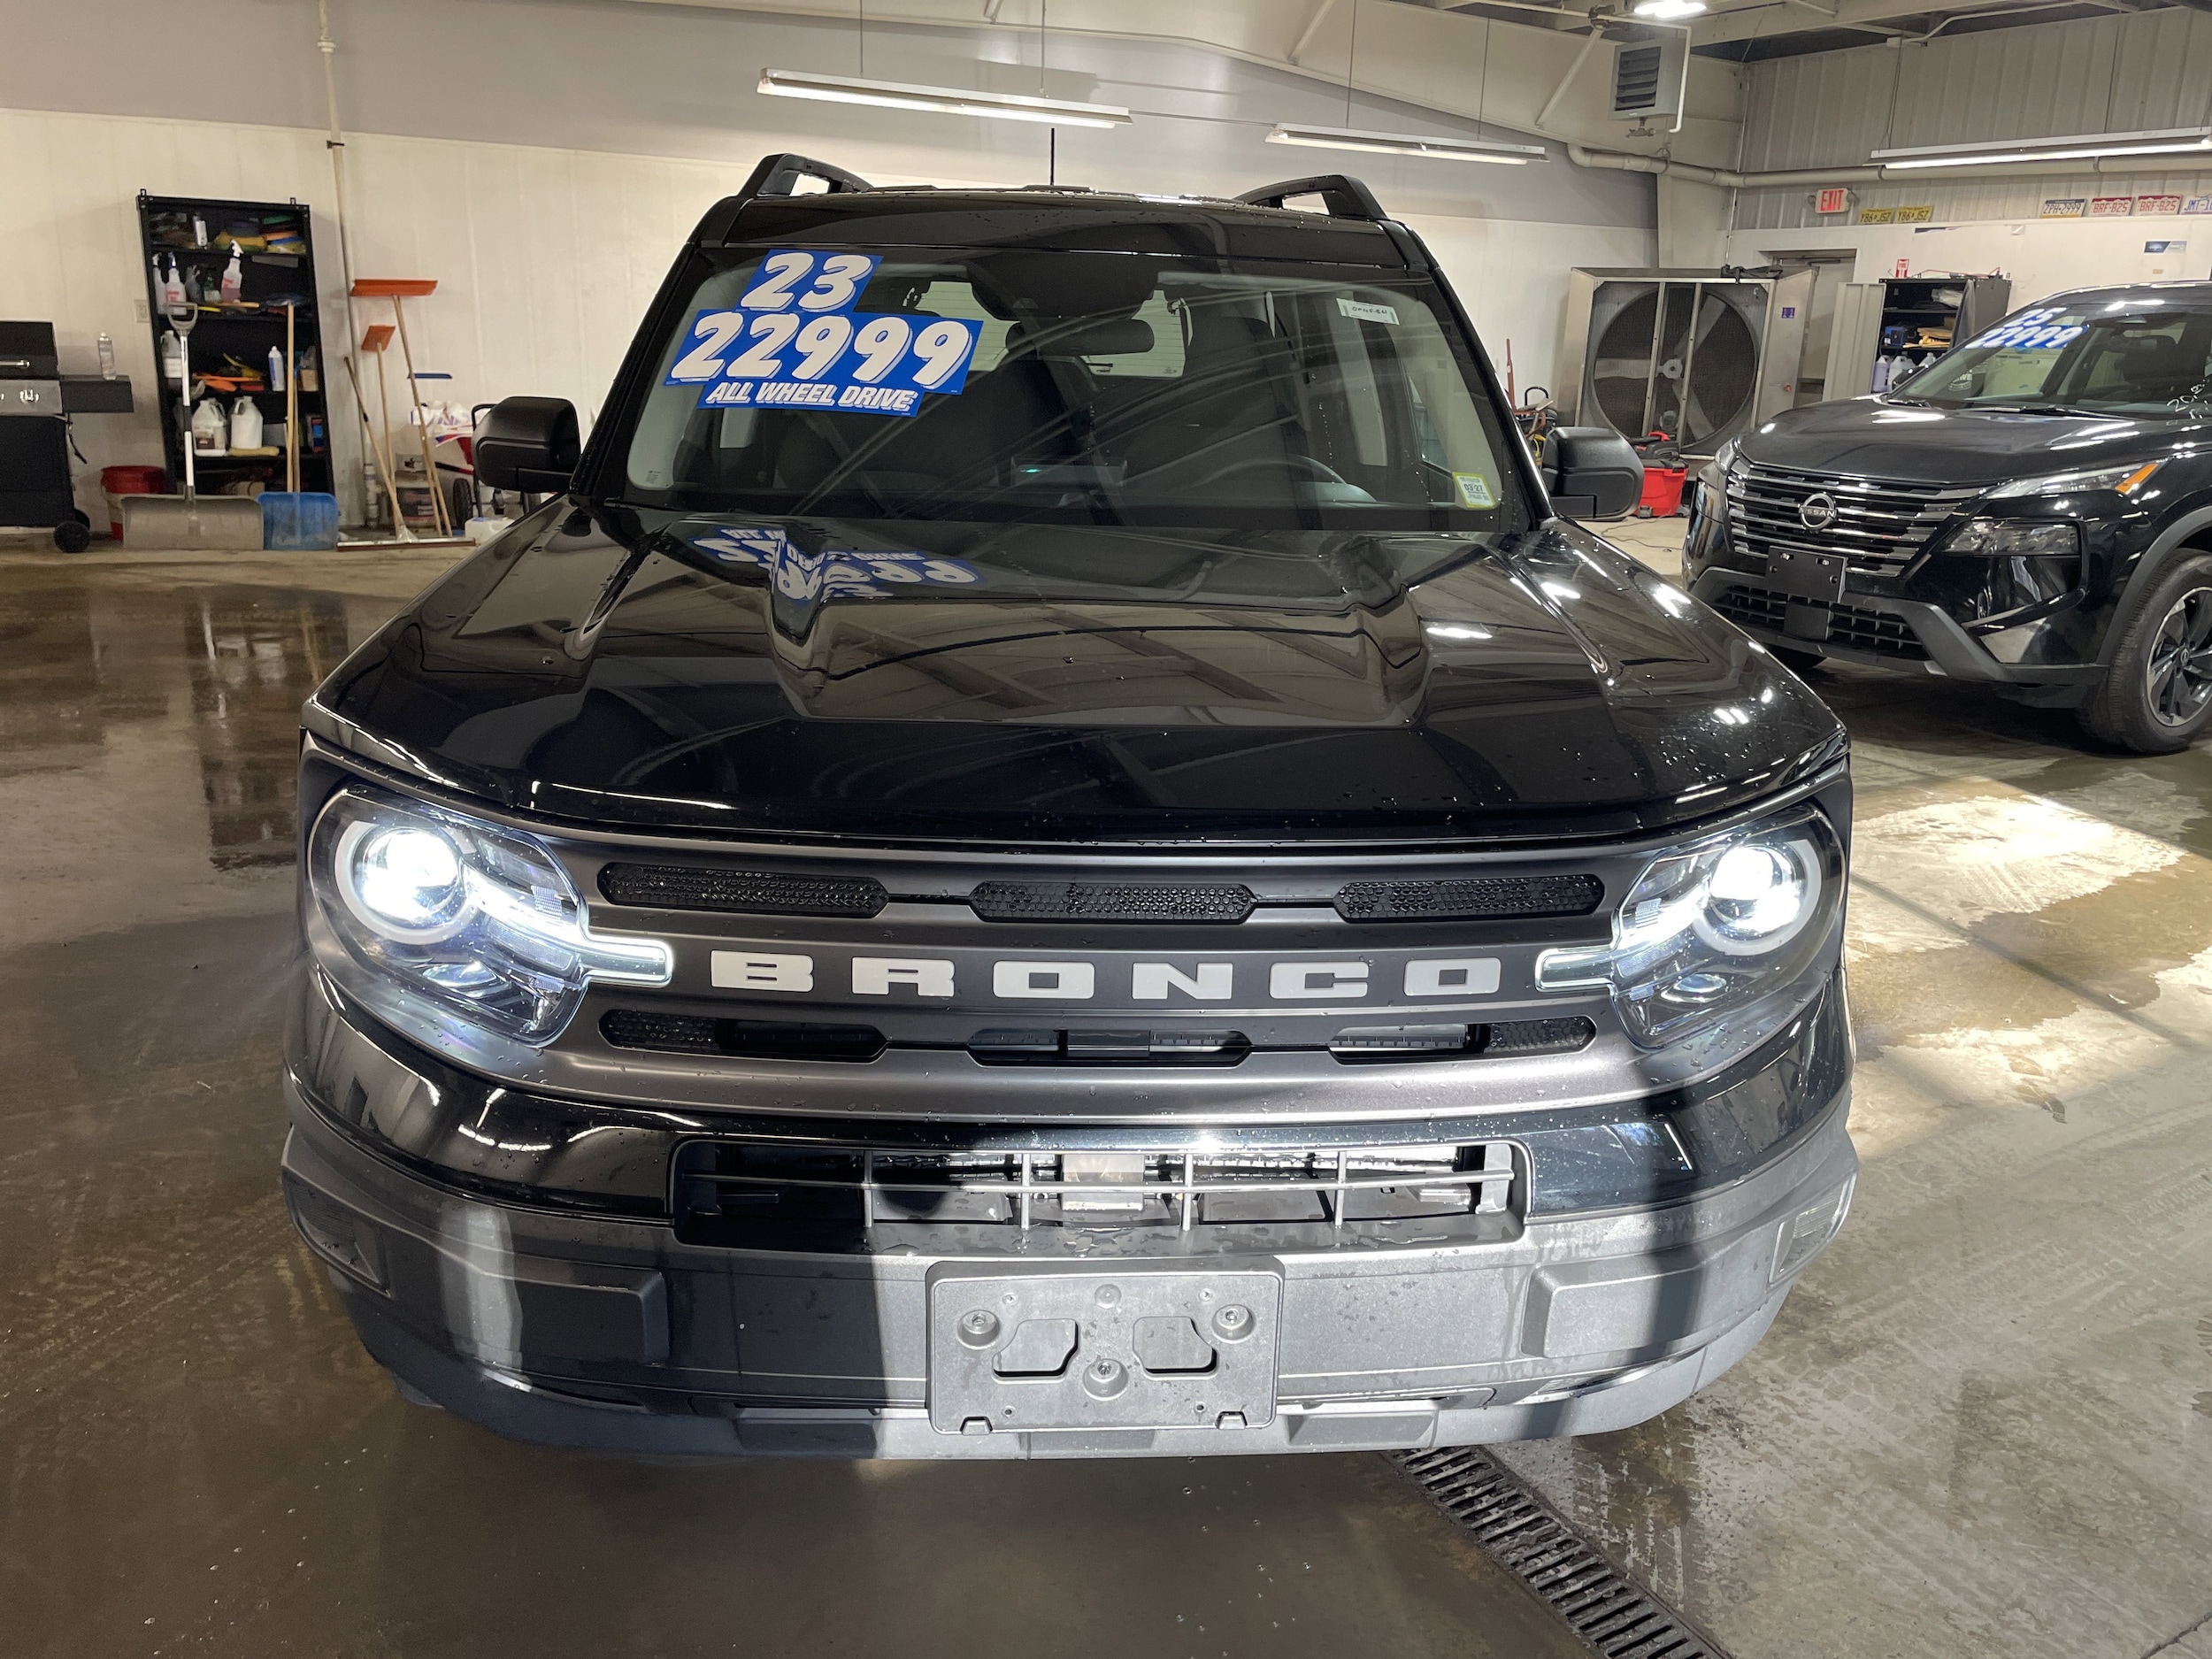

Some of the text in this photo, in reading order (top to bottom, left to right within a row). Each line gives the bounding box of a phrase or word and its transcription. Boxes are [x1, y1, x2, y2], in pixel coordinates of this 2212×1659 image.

[1820, 189, 1845, 211] EXIT
[740, 252, 874, 312] 23
[2002, 307, 2067, 327] 25
[671, 311, 973, 389] 22999
[1964, 326, 2085, 349] 22999
[705, 381, 920, 412] ALL WHEEL DRIVE
[1799, 506, 1836, 518] NISSAN
[710, 949, 1502, 1001] BRONCO
